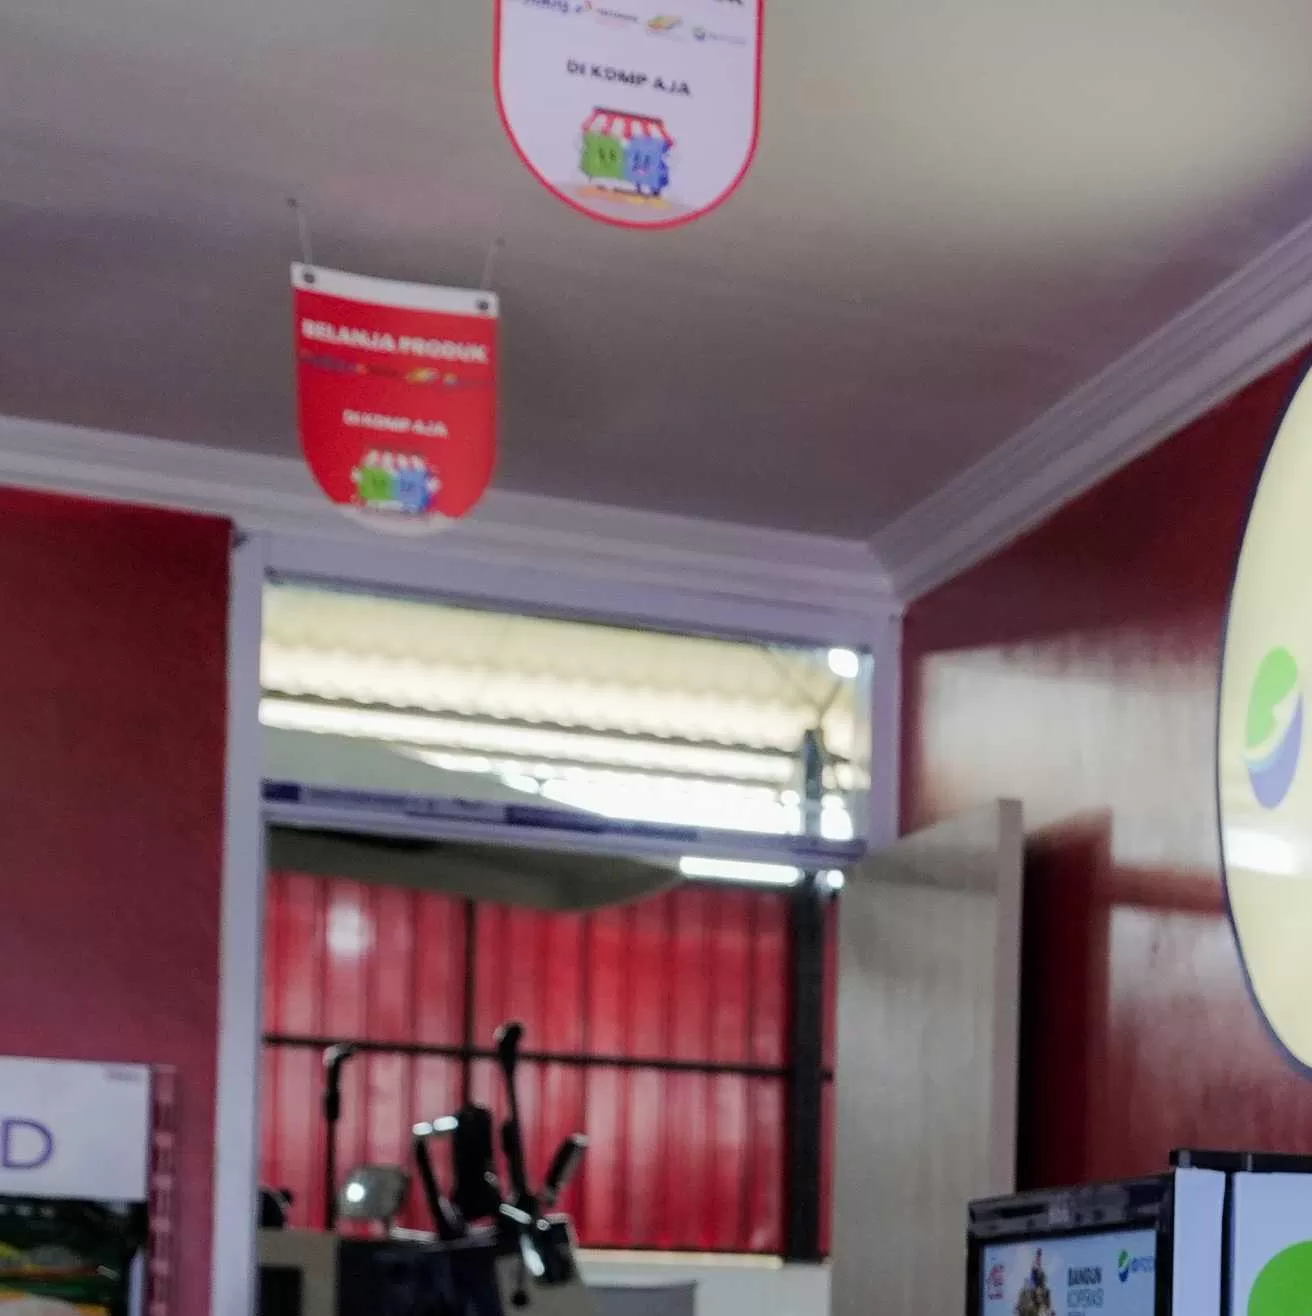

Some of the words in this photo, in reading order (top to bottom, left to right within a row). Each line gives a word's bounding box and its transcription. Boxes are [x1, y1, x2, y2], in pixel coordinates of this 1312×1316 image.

[653, 78, 691, 97] AJA
[301, 317, 396, 353] BELANJA
[398, 335, 489, 365] PRODUK
